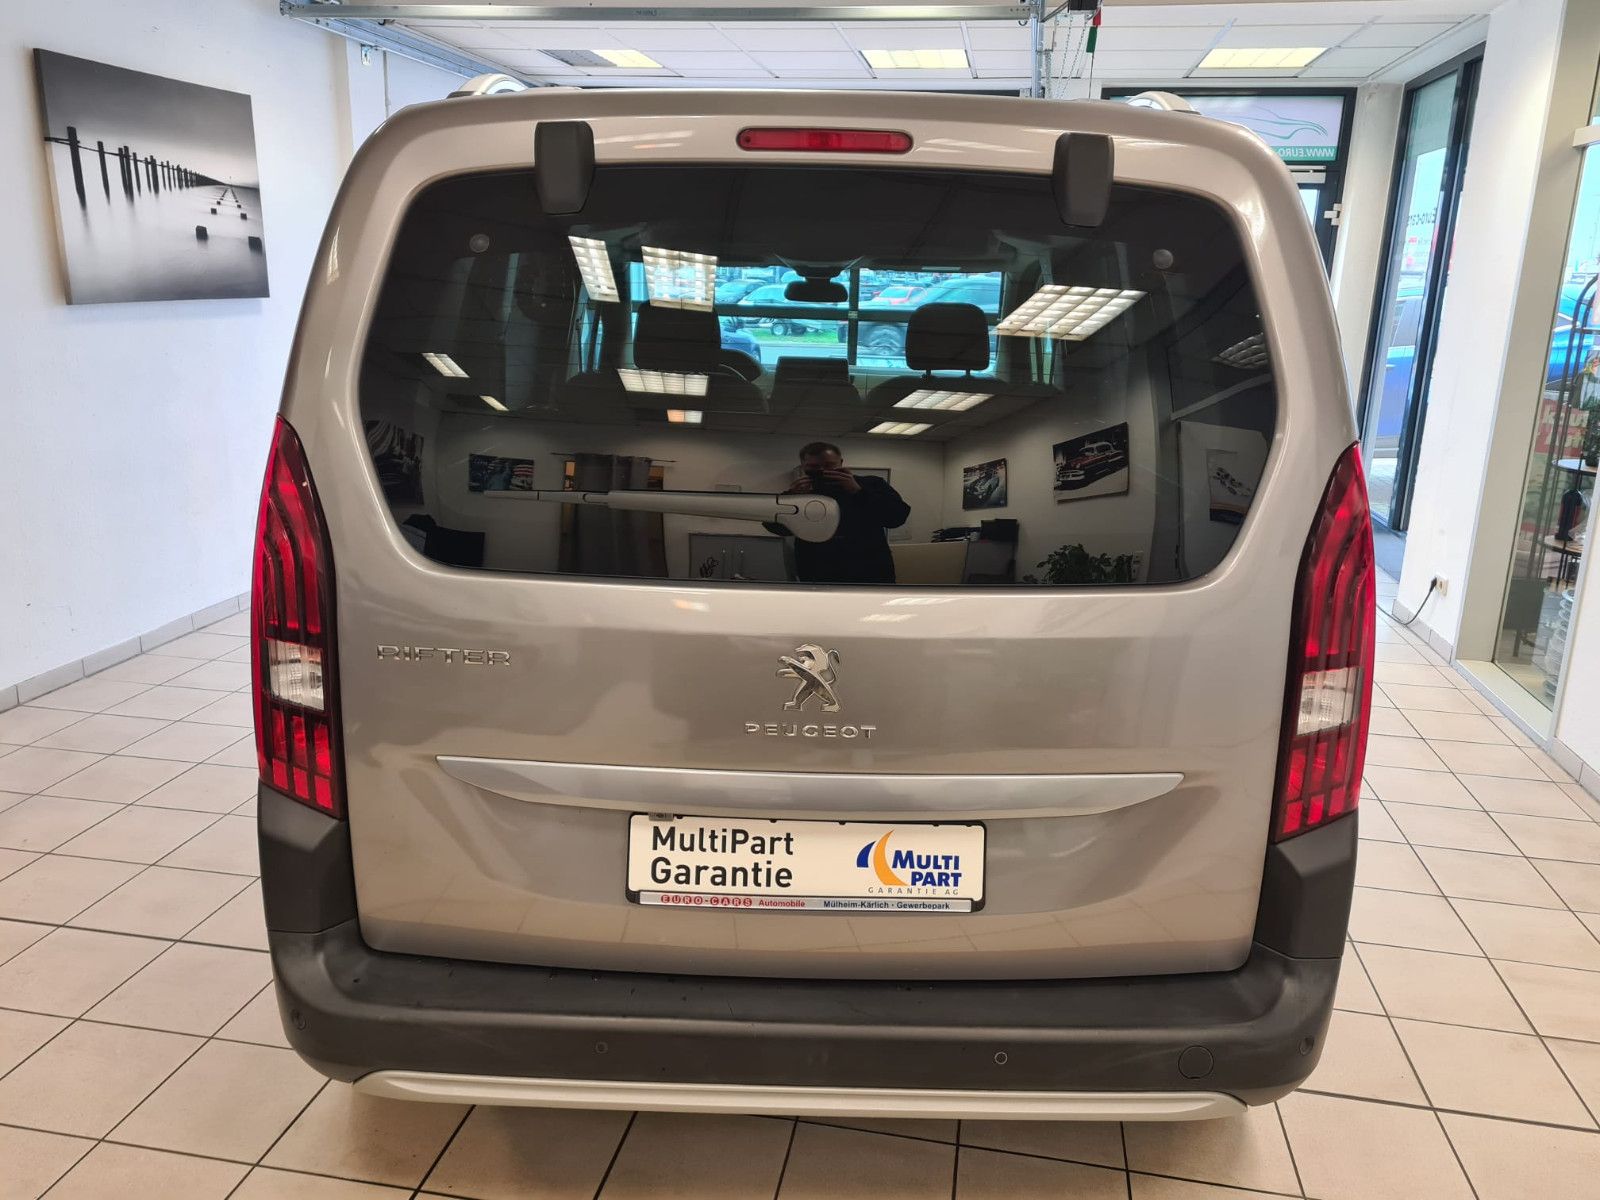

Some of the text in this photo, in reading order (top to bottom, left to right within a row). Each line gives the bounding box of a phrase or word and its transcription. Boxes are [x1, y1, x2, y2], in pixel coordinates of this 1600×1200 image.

[376, 644, 511, 666] RIFTER
[744, 723, 877, 738] PEUGEOT
[652, 826, 793, 855] MultiPart
[651, 856, 793, 888] Garantie
[911, 871, 962, 887] PART
[868, 887, 937, 895] GARANTIE
[661, 895, 805, 908] EURO-CARS Automobile
[823, 900, 950, 911] Mülheim-Kärlich Gewerbepark
